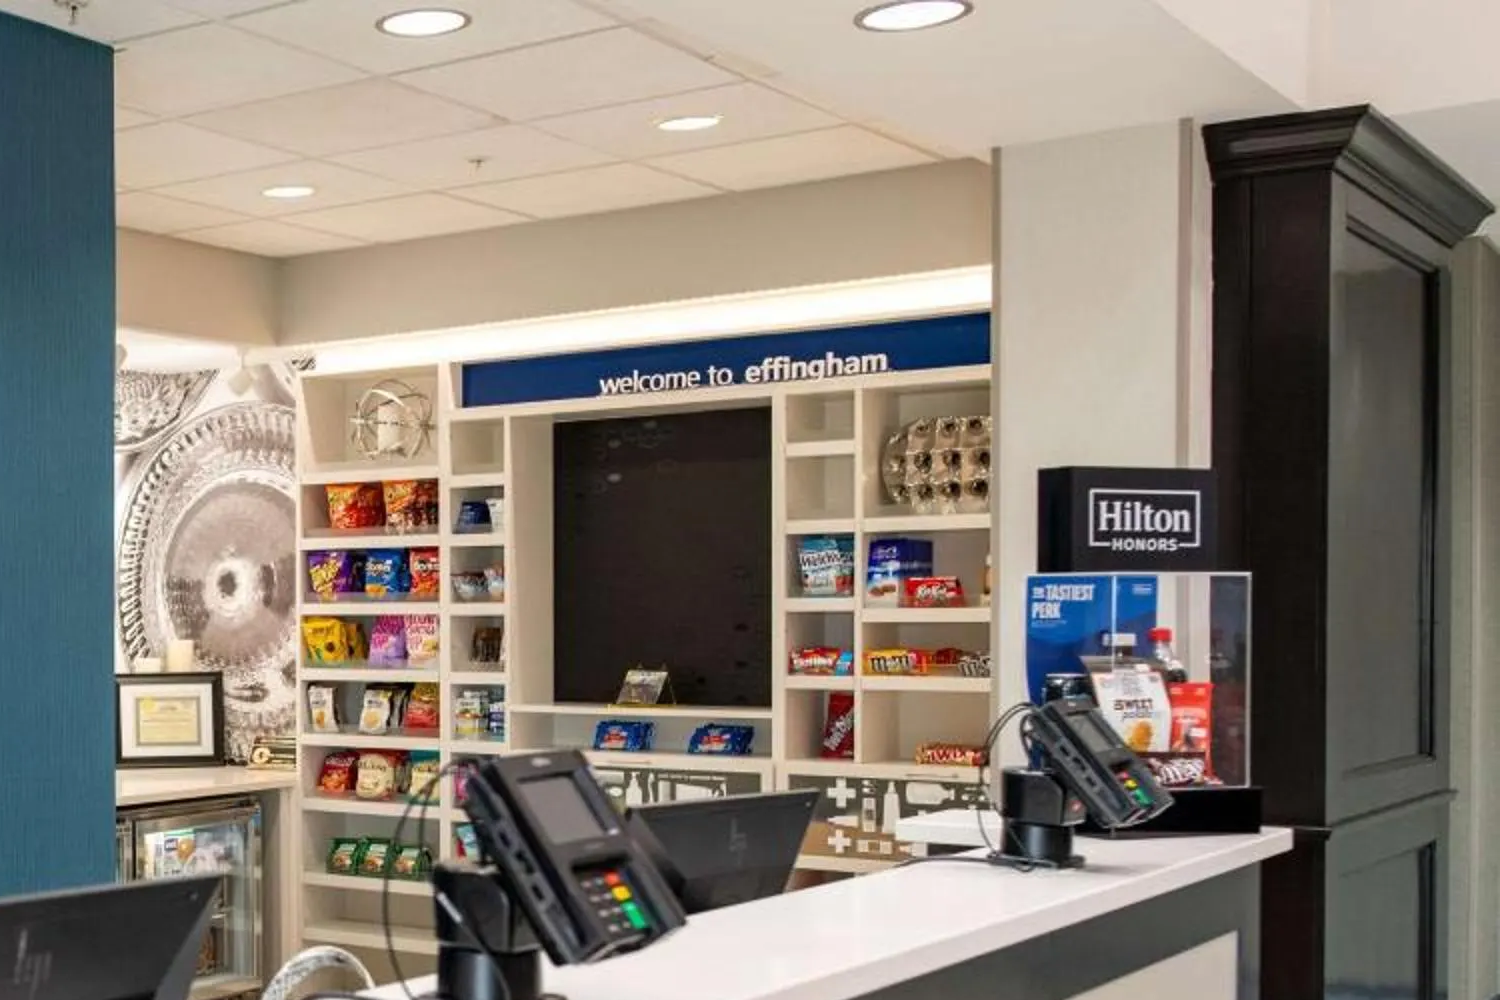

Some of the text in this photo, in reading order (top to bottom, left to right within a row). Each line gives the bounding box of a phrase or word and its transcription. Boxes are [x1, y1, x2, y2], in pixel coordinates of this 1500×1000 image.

[599, 352, 888, 394] welcome to effingham
[1097, 500, 1192, 533] Hilton
[1111, 538, 1179, 552] HONORS
